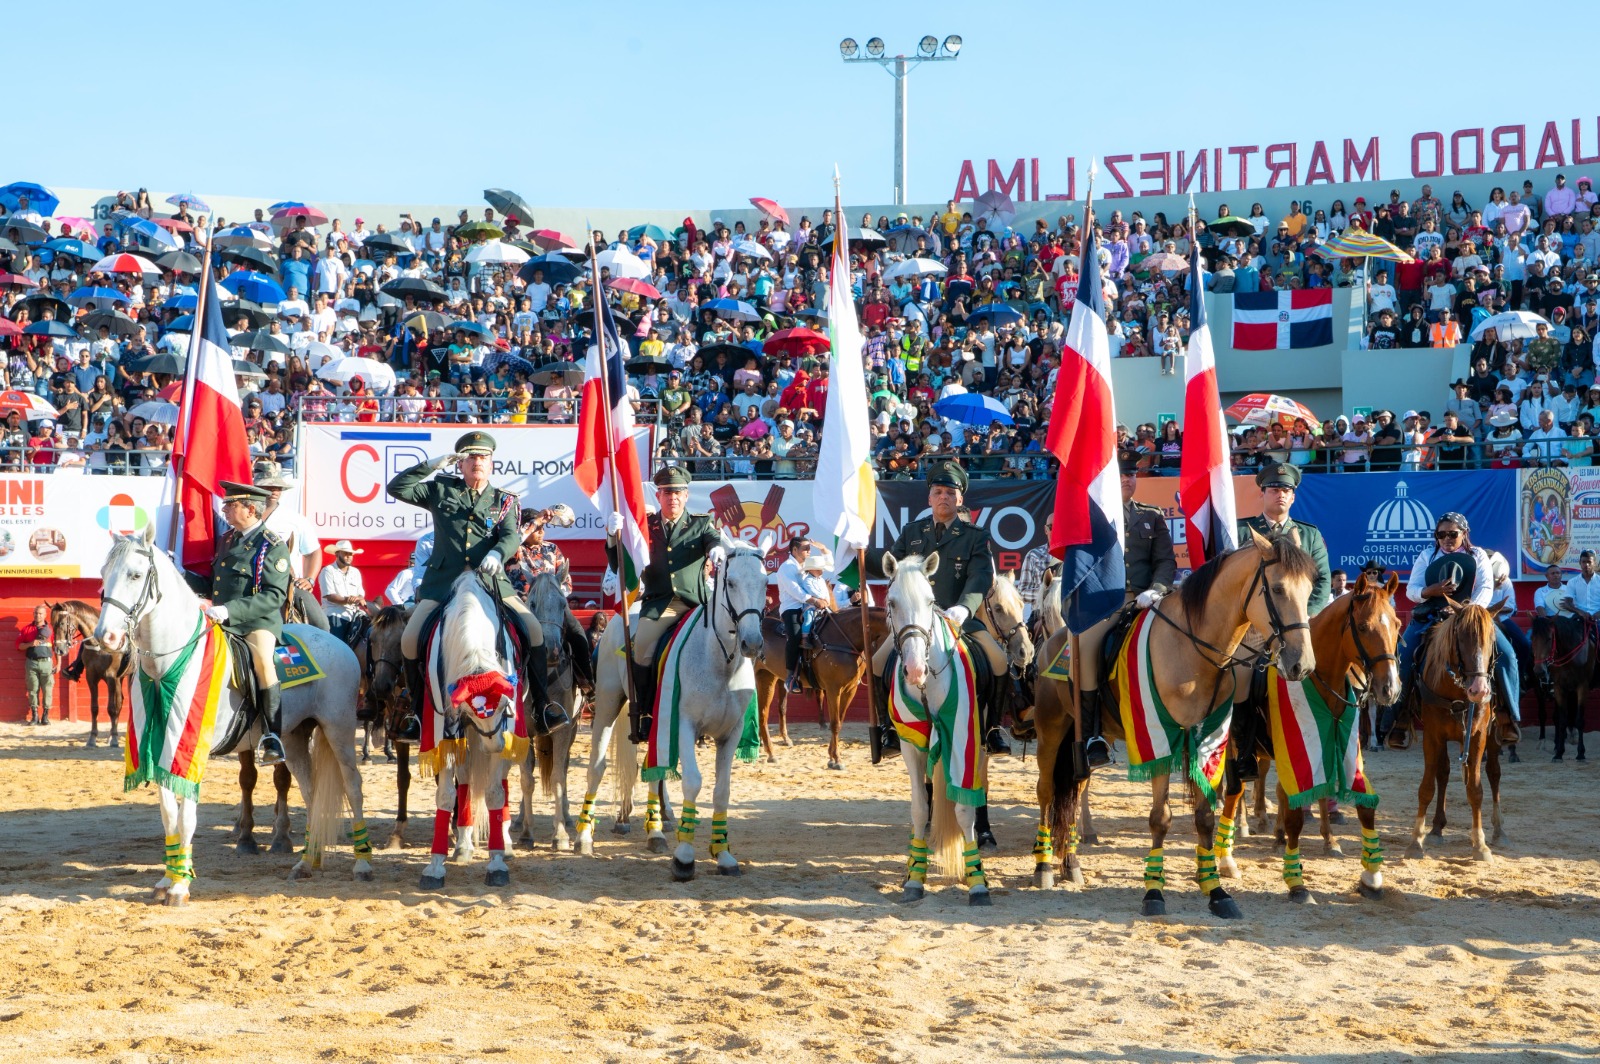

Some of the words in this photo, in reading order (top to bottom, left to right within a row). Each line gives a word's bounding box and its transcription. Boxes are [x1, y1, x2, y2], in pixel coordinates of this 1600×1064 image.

[91, 203, 110, 220] 13
[1299, 200, 1313, 216] 6
[442, 461, 527, 476] ERAL
[315, 511, 385, 528] Unidos
[393, 516, 405, 528] a
[414, 513, 428, 528] El
[875, 486, 1035, 550] NO
[1340, 555, 1408, 566] PROVINCIA
[284, 665, 309, 678] ERD
